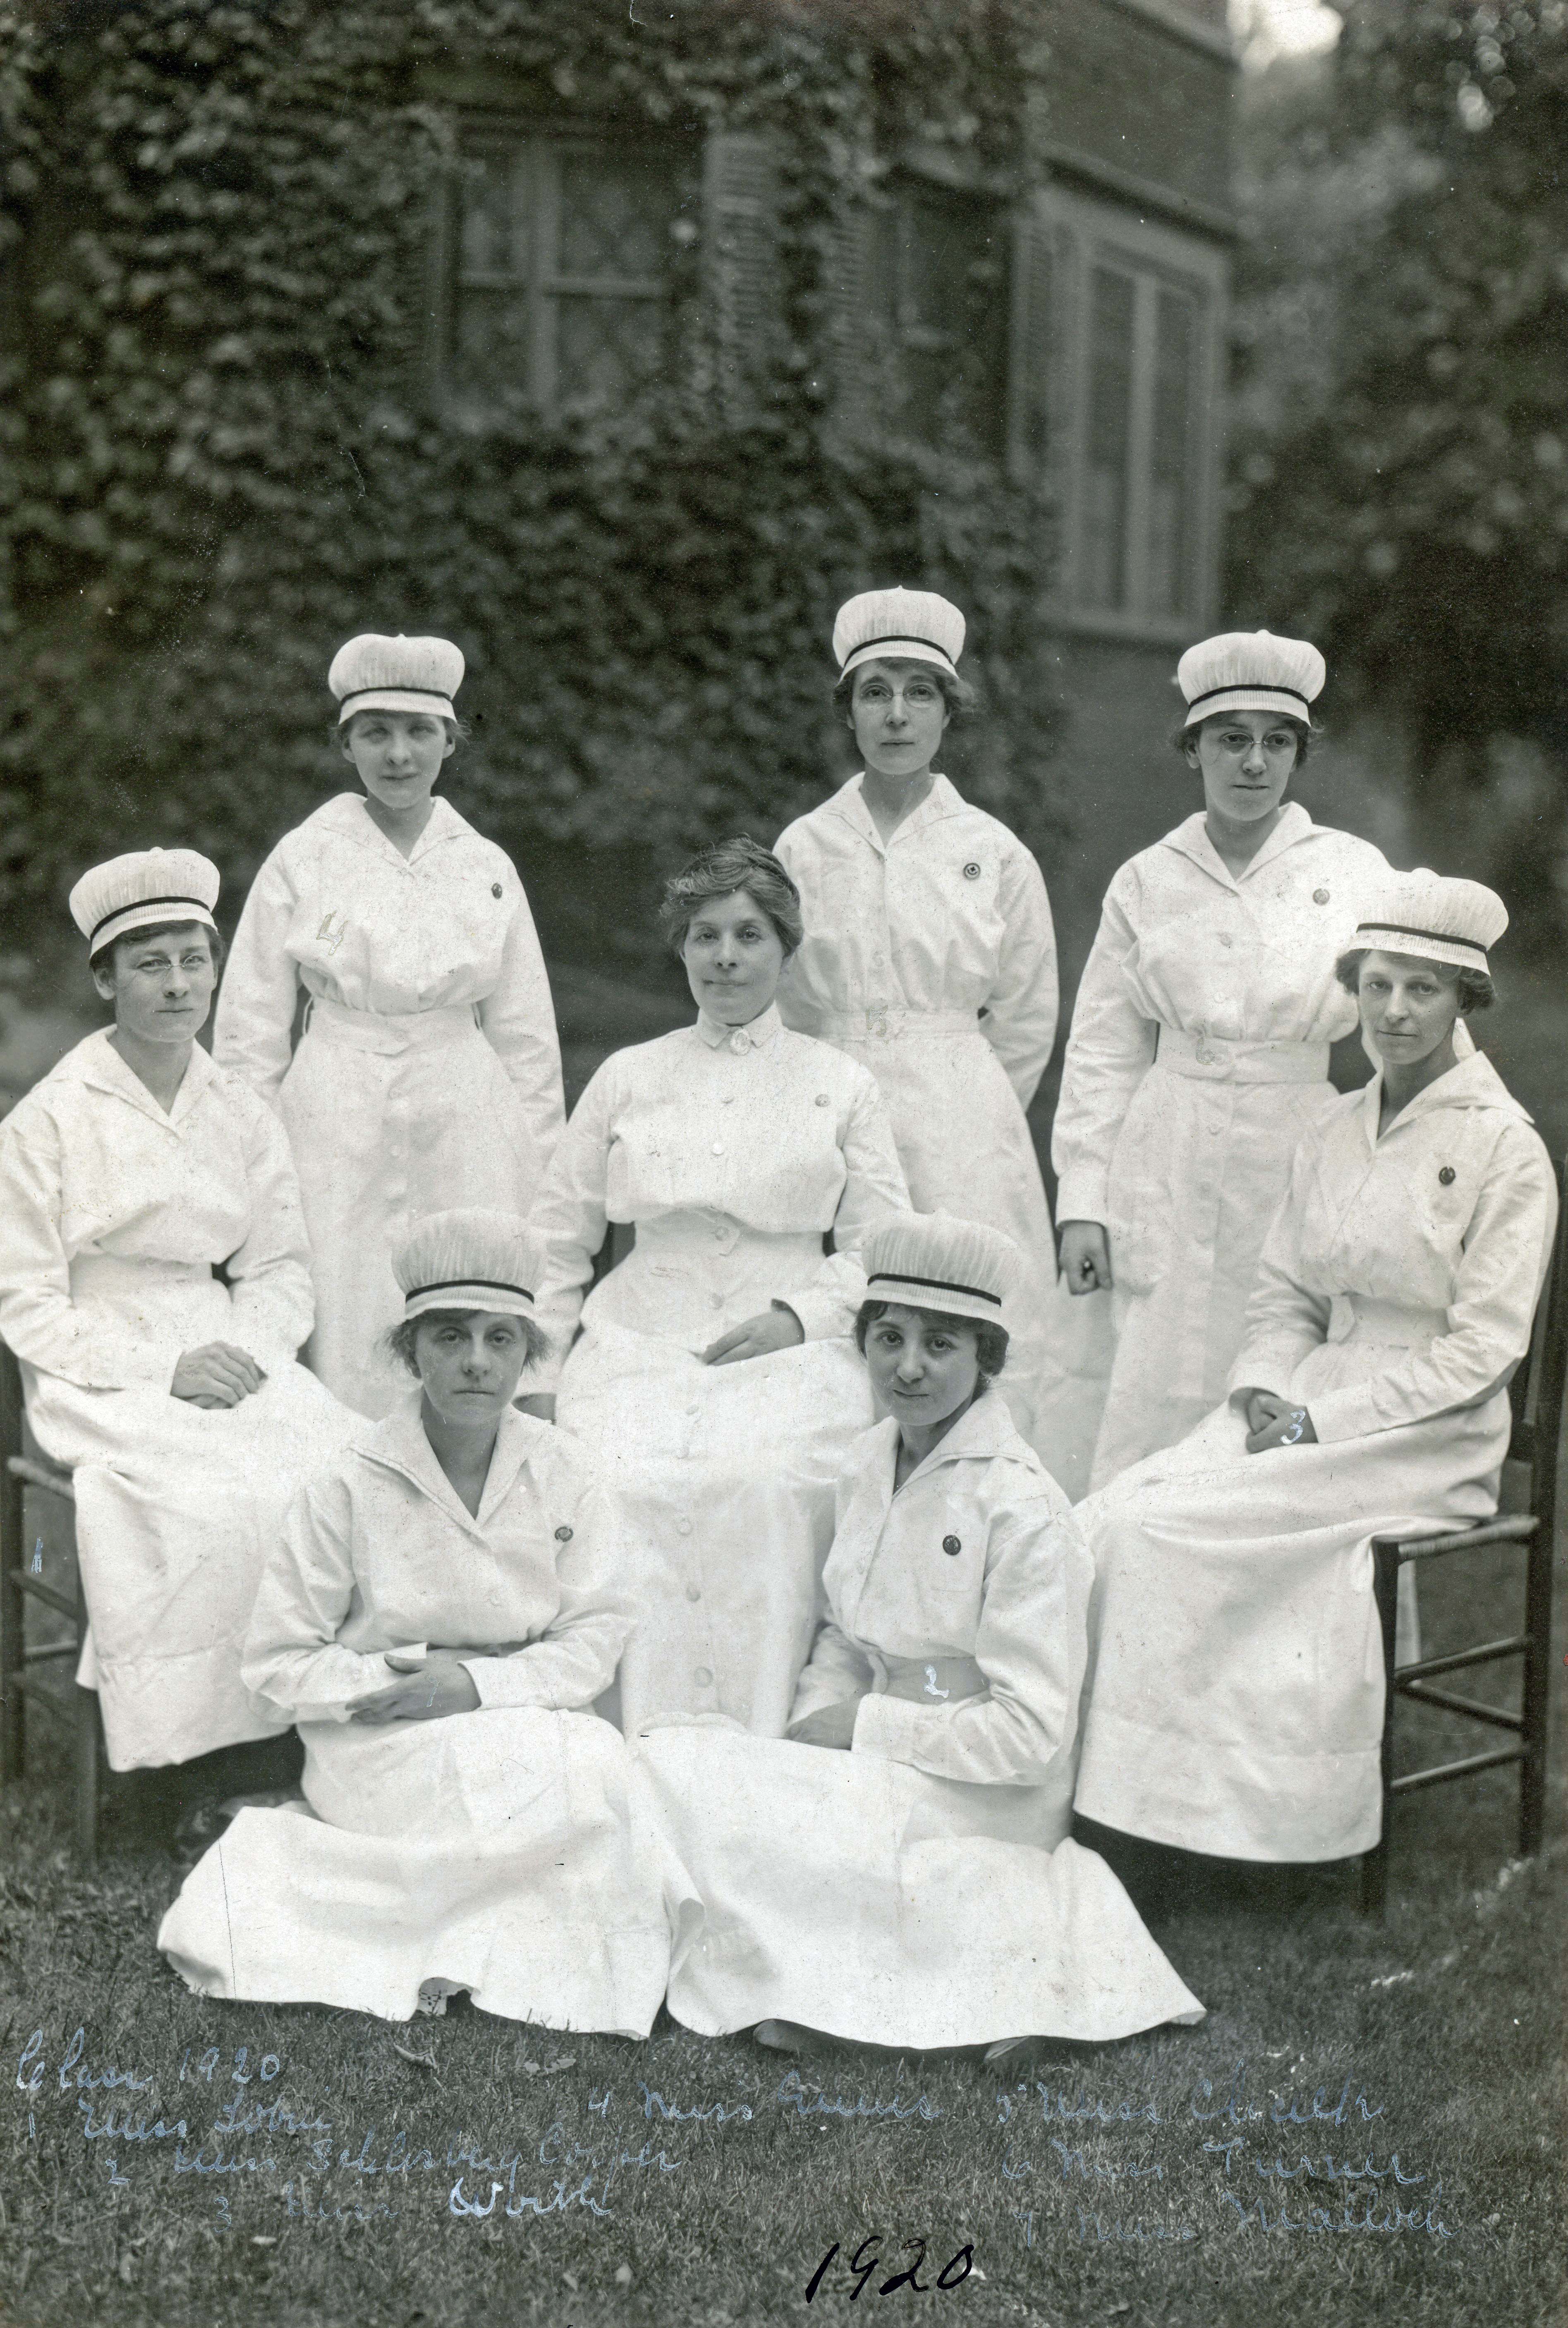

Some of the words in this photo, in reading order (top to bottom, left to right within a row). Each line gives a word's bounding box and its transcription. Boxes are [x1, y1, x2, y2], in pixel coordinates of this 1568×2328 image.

[316, 910, 349, 956] 4
[1280, 1410, 1305, 1445] 3
[923, 1665, 950, 1698] 2
[15, 2027, 153, 2090] Class
[179, 2046, 280, 2084] 1920
[28, 2112, 36, 2139] 1
[77, 2096, 187, 2139] Miss
[588, 2087, 610, 2120] 4
[637, 2080, 753, 2122] Miss
[996, 2082, 1027, 2123] 5
[1036, 2077, 1164, 2125] Miss
[105, 2158, 131, 2185] 2
[174, 2139, 276, 2175] Miss
[1001, 2141, 1032, 2180] 6
[1050, 2138, 1164, 2181] Miss
[1202, 2137, 1426, 2185] Turner
[213, 2195, 232, 2233] 3
[284, 2179, 400, 2222] Miss
[449, 2175, 614, 2218] Worth
[1012, 2209, 1033, 2248] 7
[1075, 2206, 1196, 2242] Miss
[805, 2236, 974, 2303] 1920
